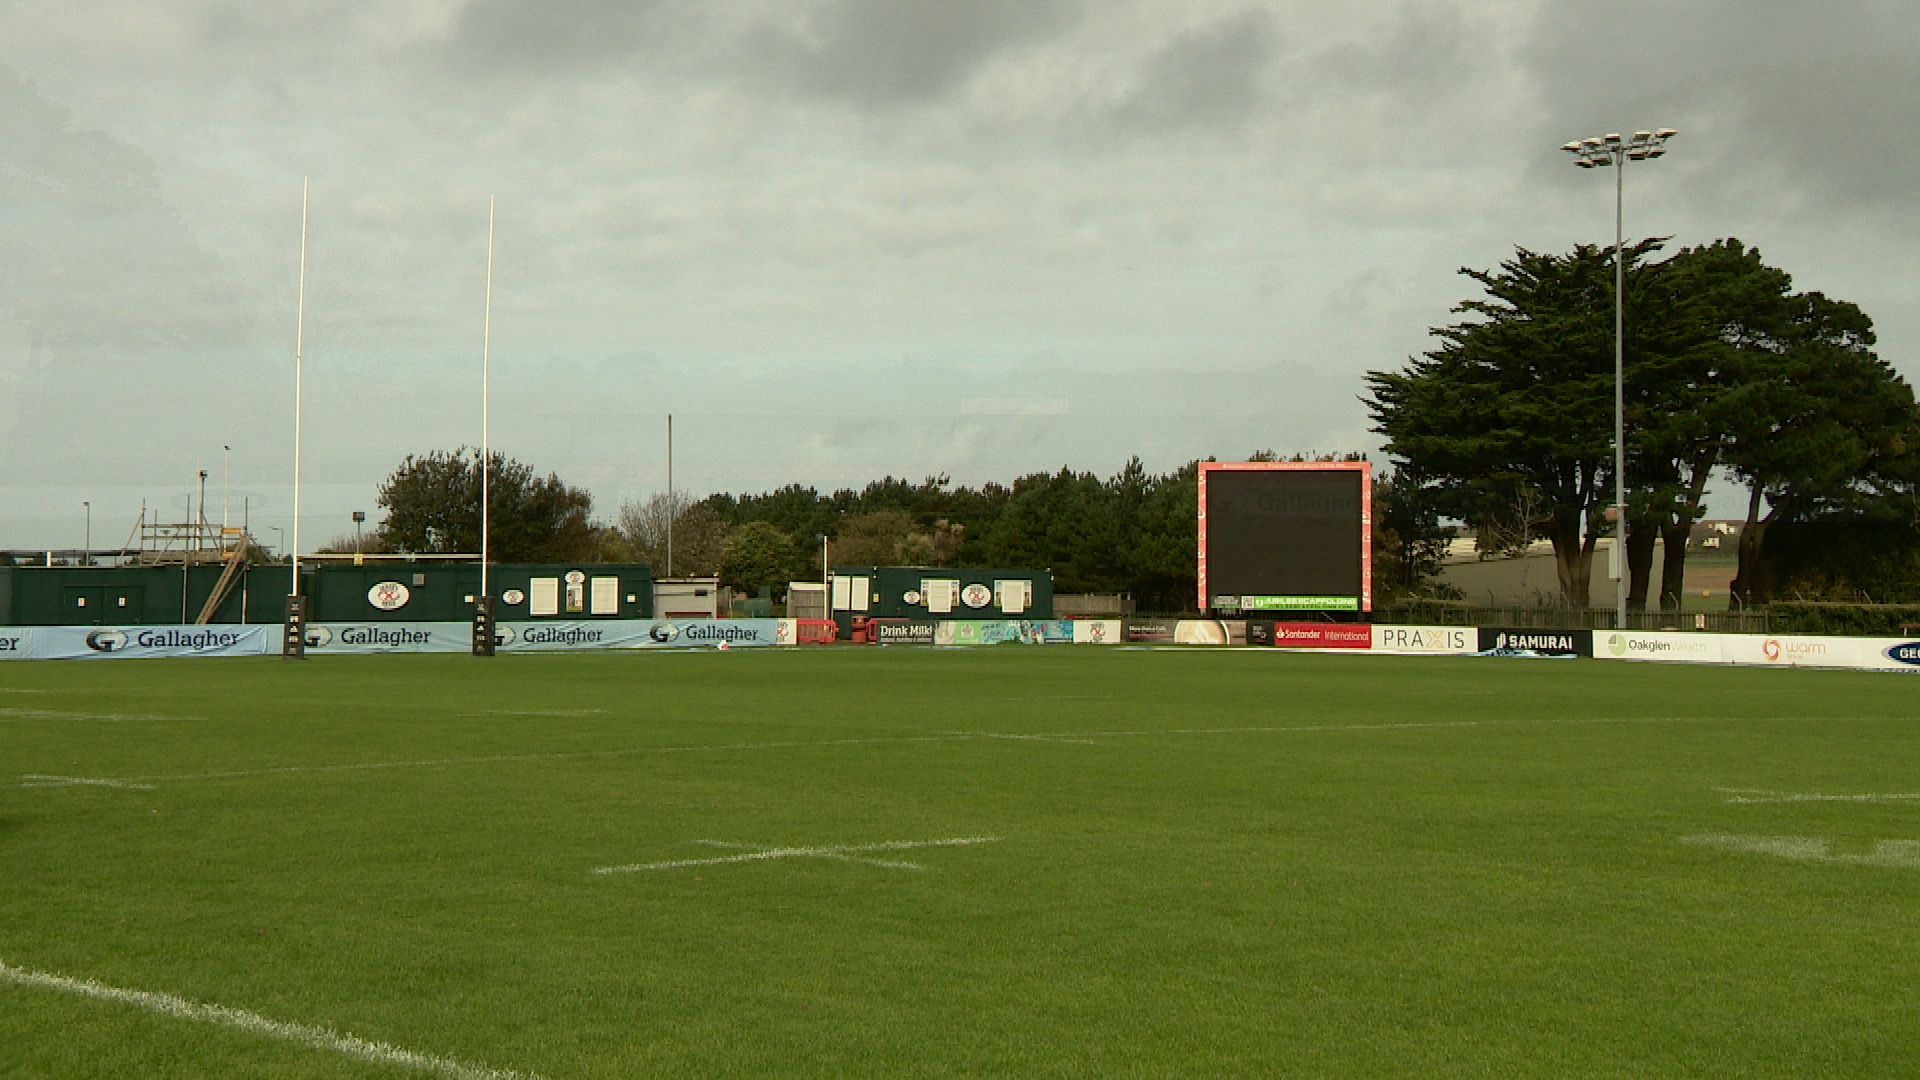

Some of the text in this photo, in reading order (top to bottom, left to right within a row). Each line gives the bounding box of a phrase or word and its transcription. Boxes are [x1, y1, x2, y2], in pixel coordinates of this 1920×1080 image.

[138, 629, 241, 650] Gallagher
[340, 627, 432, 646] Gallagher
[523, 626, 604, 646] Gallagher
[686, 624, 759, 643] Gallagher
[880, 625, 908, 637] Drink
[1285, 629, 1369, 641] Santander International
[1383, 629, 1465, 649] PRAXIS
[1508, 635, 1573, 650] SAMURAI
[1785, 642, 1826, 655] warm
[1899, 647, 1920, 659] GE
